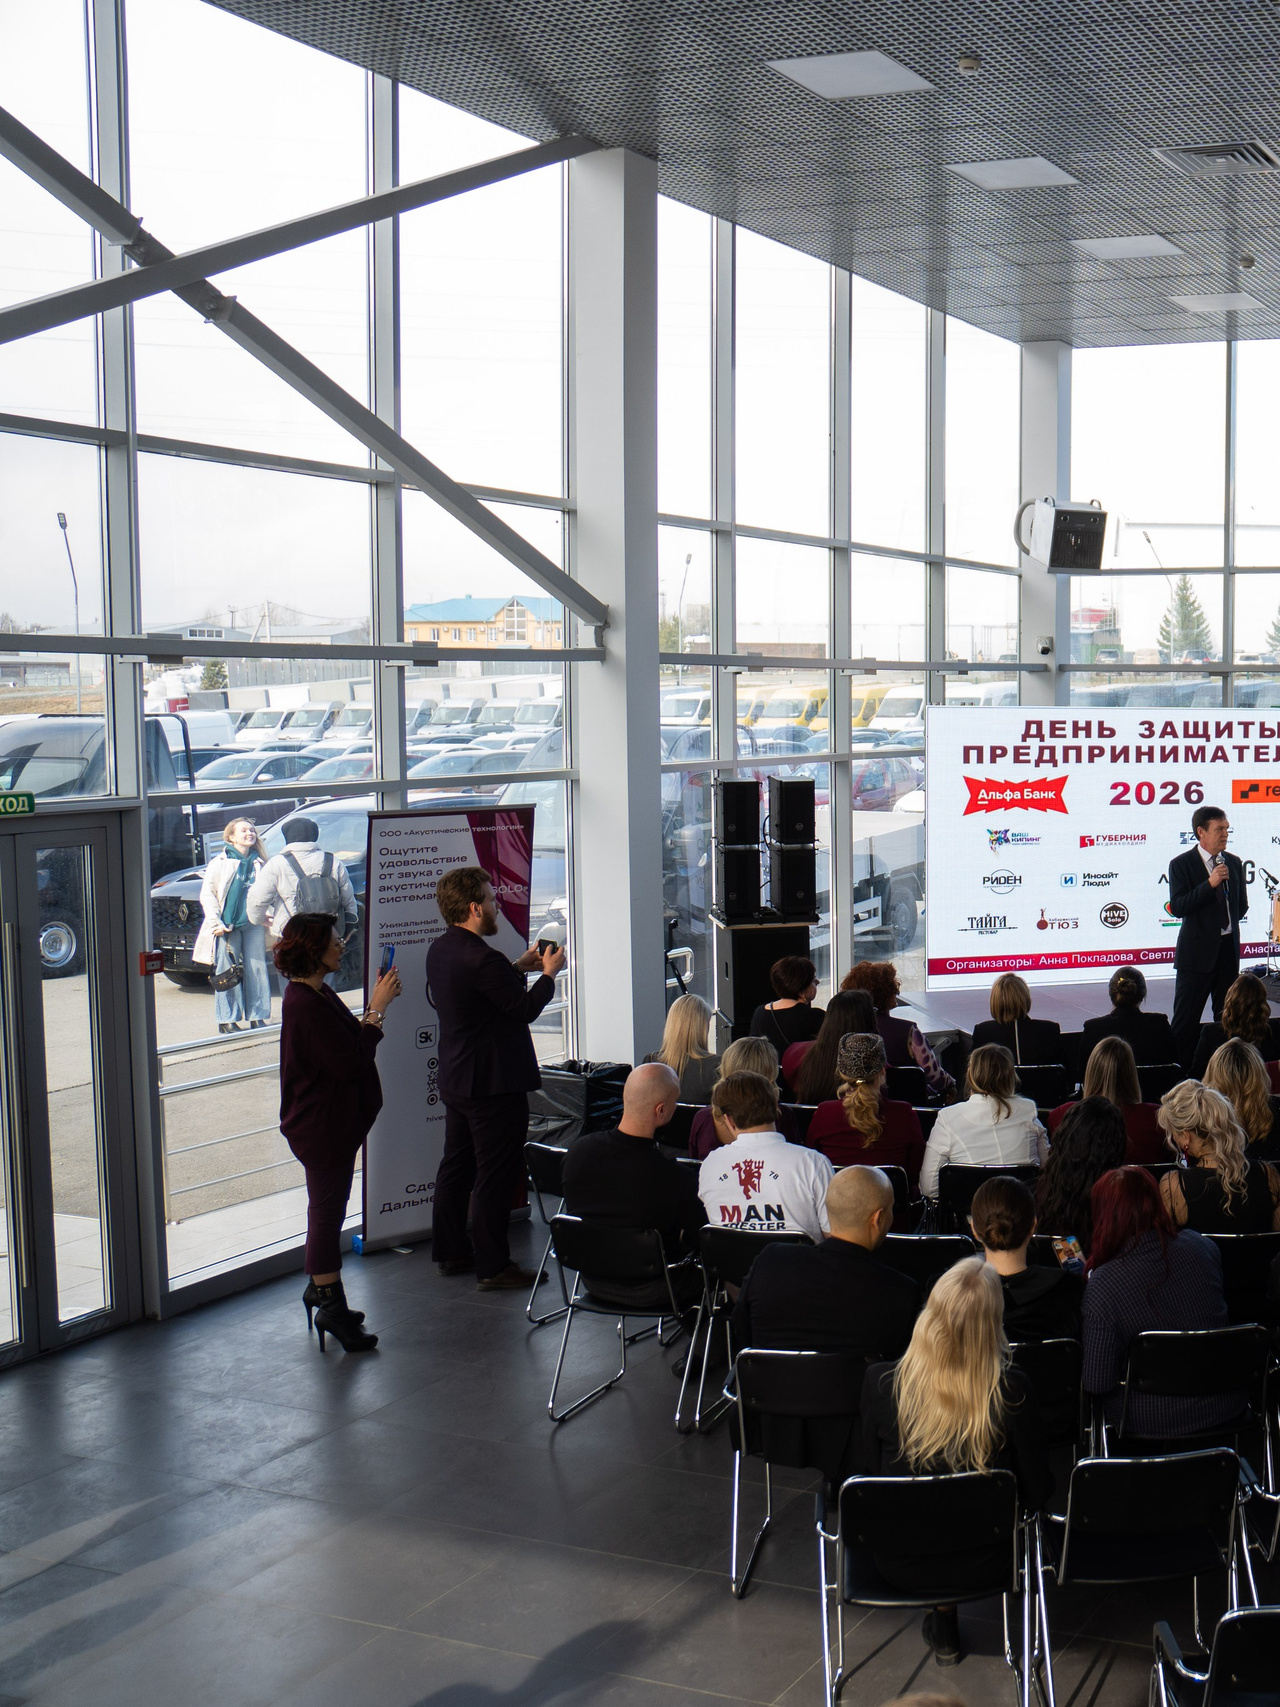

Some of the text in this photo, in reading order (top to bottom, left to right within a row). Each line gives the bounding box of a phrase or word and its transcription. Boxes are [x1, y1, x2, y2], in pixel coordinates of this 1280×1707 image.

[1021, 719, 1117, 742] ДЕНЬ
[977, 788, 1056, 803] Альфа Банк
[1109, 781, 1205, 805] 2026
[404, 827, 470, 836] «Акустические
[379, 846, 438, 856] Ощутите
[379, 855, 468, 869] удовольствие
[397, 870, 433, 879] звука
[379, 881, 437, 892] акустиче
[379, 919, 439, 929] Уникальные
[967, 913, 1007, 929] ТАЙГА
[1049, 921, 1079, 930] ТЮЗ
[946, 957, 1036, 971] Организаторы:
[1039, 956, 1068, 965] Анна
[1071, 953, 1137, 963] Покладова,
[1140, 950, 1176, 960] Светл
[419, 1031, 433, 1043] Sk
[719, 1170, 779, 1182] 18 78
[405, 1182, 436, 1193] Сде
[380, 1195, 435, 1214] Дальне
[719, 1204, 786, 1222] MAN
